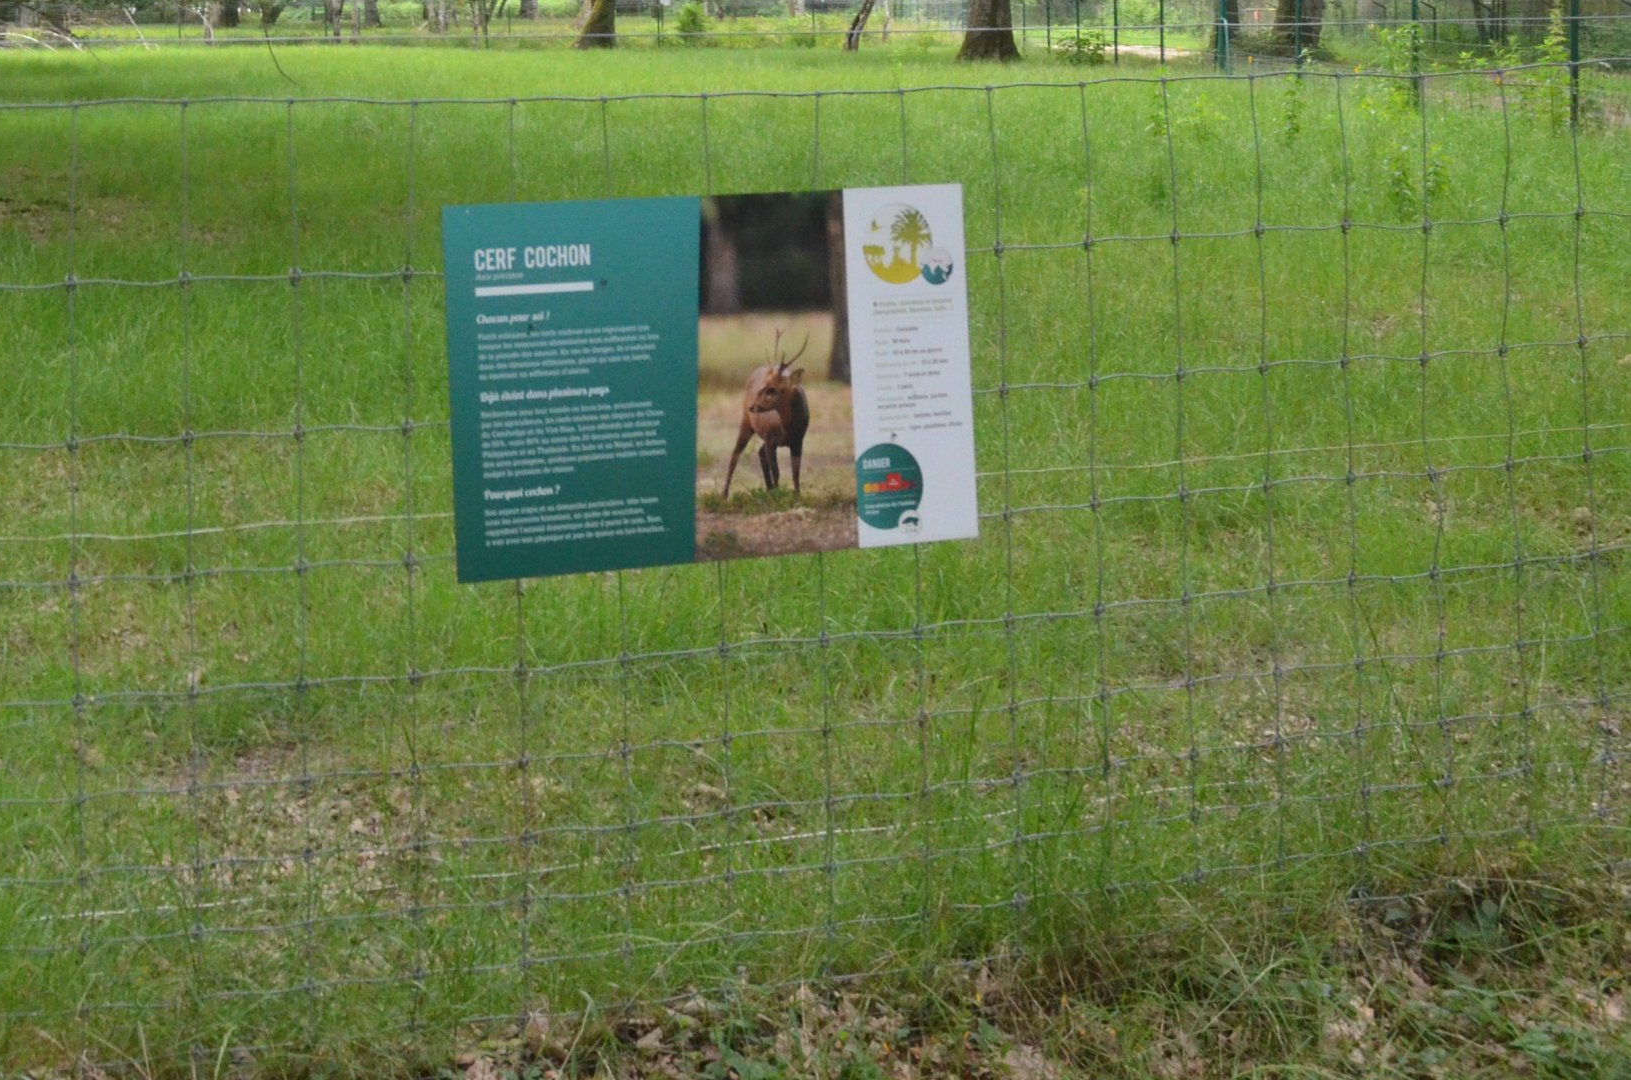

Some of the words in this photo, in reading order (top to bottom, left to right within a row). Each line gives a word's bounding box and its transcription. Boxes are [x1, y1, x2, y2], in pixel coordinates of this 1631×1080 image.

[474, 247, 517, 271] CERF
[524, 244, 592, 269] COCHON
[509, 314, 530, 326] pour
[526, 389, 548, 400] dans
[548, 387, 588, 400] plusieurs
[483, 486, 524, 501] Pourquoi
[524, 485, 554, 498] cochon
[555, 484, 561, 496] ?
